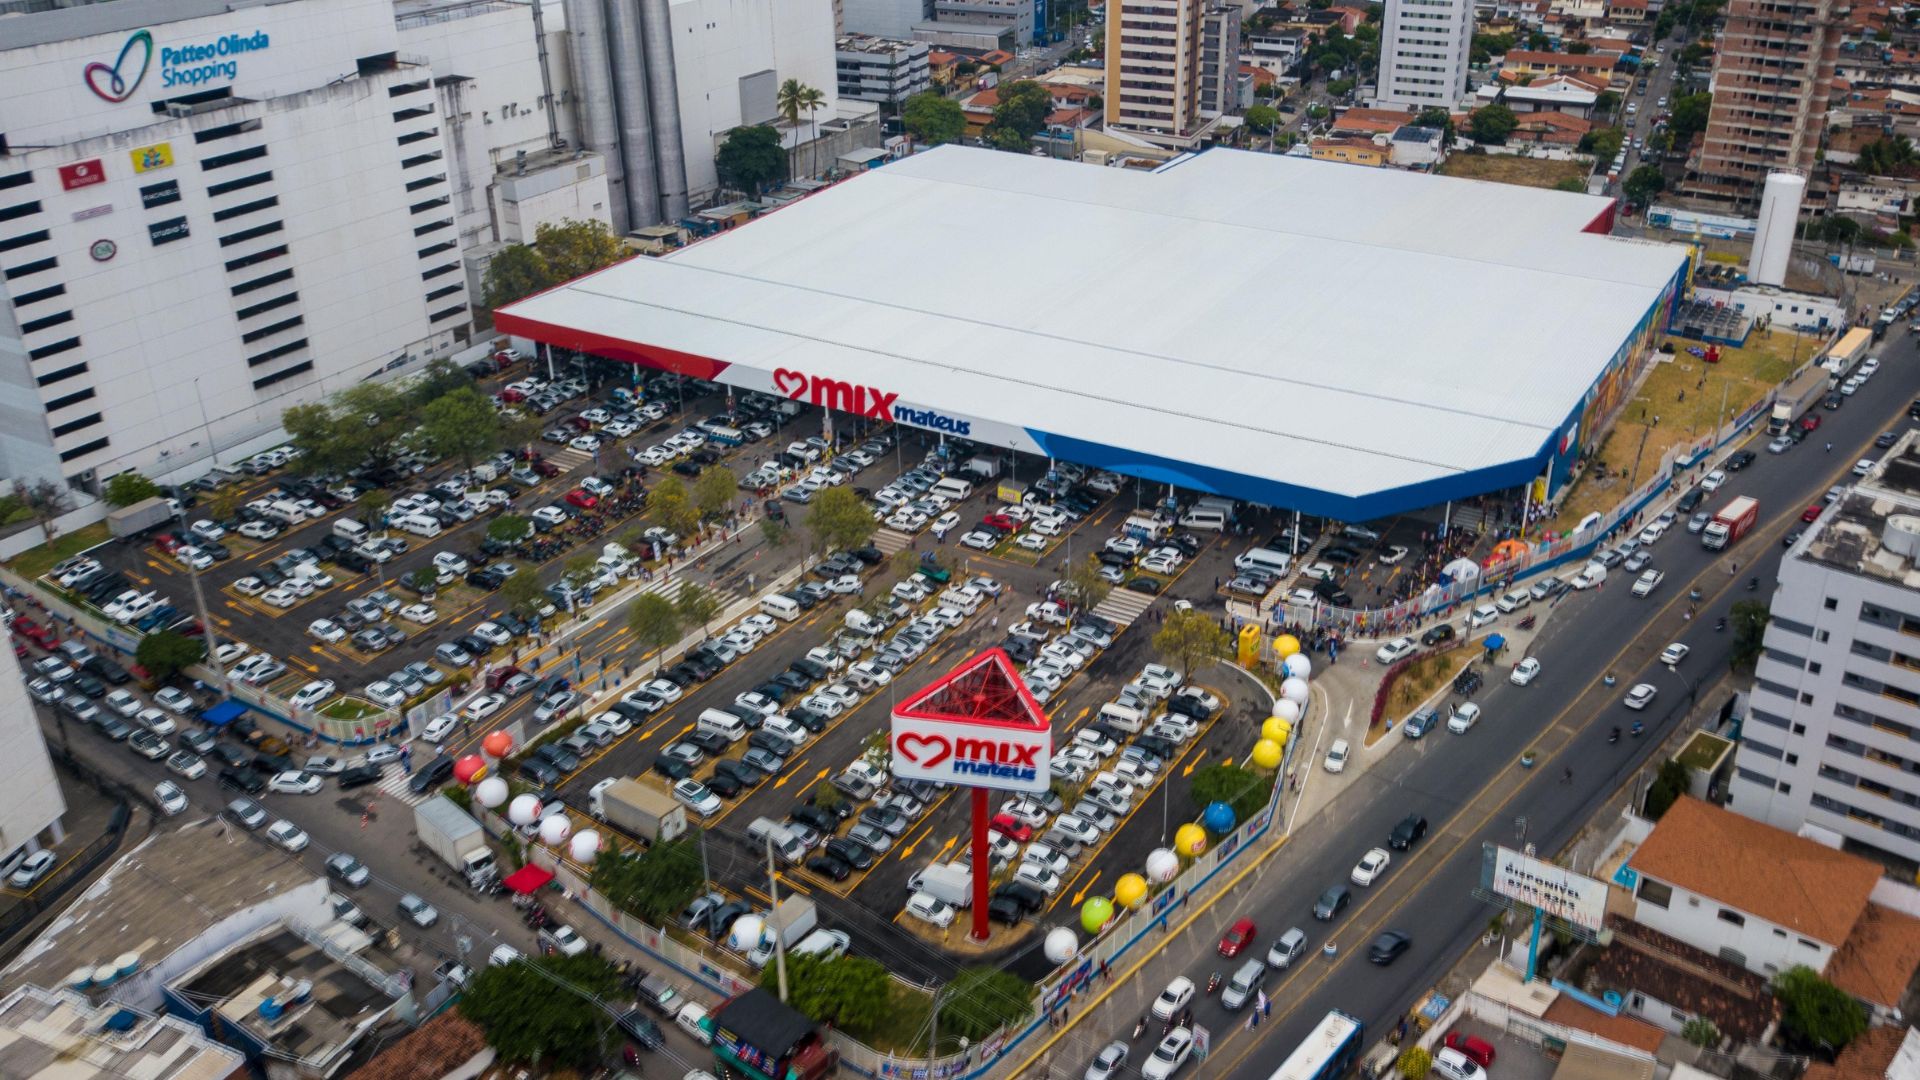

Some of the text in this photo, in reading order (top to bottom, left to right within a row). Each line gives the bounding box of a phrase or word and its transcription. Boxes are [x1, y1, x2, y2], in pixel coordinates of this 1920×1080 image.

[161, 29, 270, 68] Patteo Olinda
[161, 60, 237, 88] Shopping
[894, 404, 970, 436] mateus
[953, 759, 1037, 781] mateus
